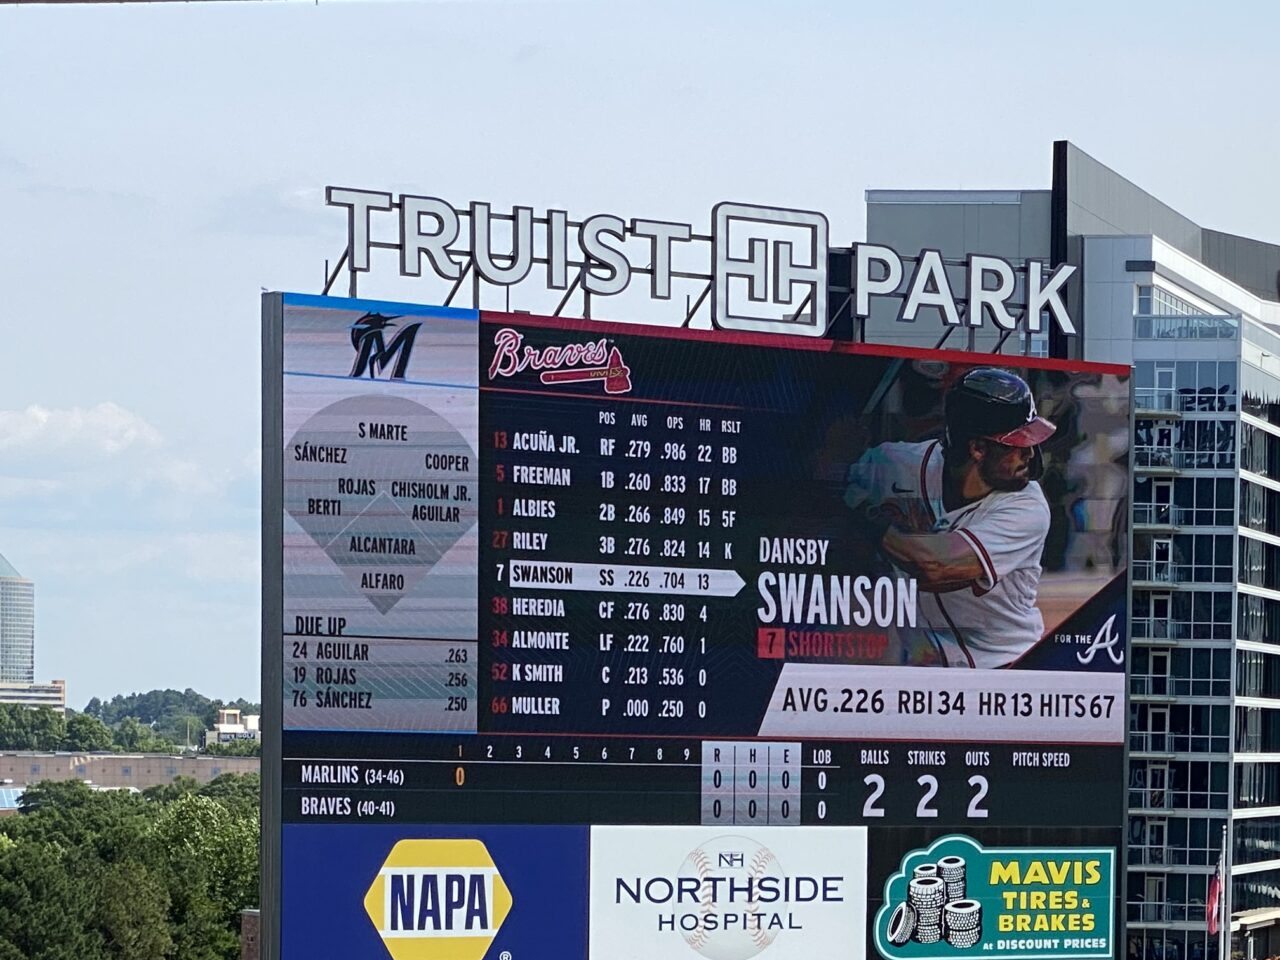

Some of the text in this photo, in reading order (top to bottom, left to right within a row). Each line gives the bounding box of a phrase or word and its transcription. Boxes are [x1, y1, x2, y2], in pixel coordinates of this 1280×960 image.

[325, 185, 693, 300] TRUIST
[852, 241, 1080, 336] PARK
[488, 328, 607, 379] Braves
[358, 423, 408, 442] S MARTE
[513, 430, 580, 454] ACUÑA JR.
[294, 442, 347, 464] SÁNCHEZ
[425, 454, 469, 472] COOPER
[513, 465, 571, 486] FREEMAN
[338, 478, 376, 496] ROJAS
[391, 481, 471, 502] CHISHOLM JR.
[308, 498, 341, 516] BERTI
[412, 505, 460, 523] AGUILAR
[513, 499, 556, 518] ALBIES
[350, 536, 416, 555] ALCANTARA
[513, 532, 548, 550] RILEY
[759, 537, 829, 567] DANSBY
[361, 573, 404, 590] ALFARO
[513, 565, 573, 584] SWANSON
[513, 597, 565, 617] HEREDIA
[757, 571, 918, 629] SWANSON
[295, 615, 346, 636] DUE UP
[512, 631, 569, 650] ALMONTE
[788, 631, 889, 660] SHORTSTOP
[1055, 634, 1092, 645] FOR THE
[316, 642, 369, 661] AGUILAR
[316, 667, 356, 685] ROJAS
[512, 664, 563, 683] K SMITH
[316, 687, 372, 709] SÁNCHEZ
[512, 697, 560, 715] MULLER
[782, 686, 1115, 720] AVG .226 RBI 34 HR 13 HITS 67
[813, 749, 832, 765] LOB
[861, 749, 889, 765] BALLS
[907, 750, 946, 766] STRIKES
[965, 750, 990, 766] OUTS
[1012, 751, 1070, 768] PITCH SPEED
[301, 765, 405, 786] MARLINS (34-46)
[301, 797, 395, 817] BRAVES (40-41)
[989, 861, 1101, 885] MAVIS
[616, 876, 844, 904] NORTHSIDE
[390, 874, 489, 931] NAPA
[1002, 890, 1091, 910] TIRES &
[658, 913, 802, 931] HOSPITAL
[998, 913, 1095, 932] BRAKES
[997, 939, 1060, 950] DISCOUNT
[1063, 938, 1106, 949] PRICES
